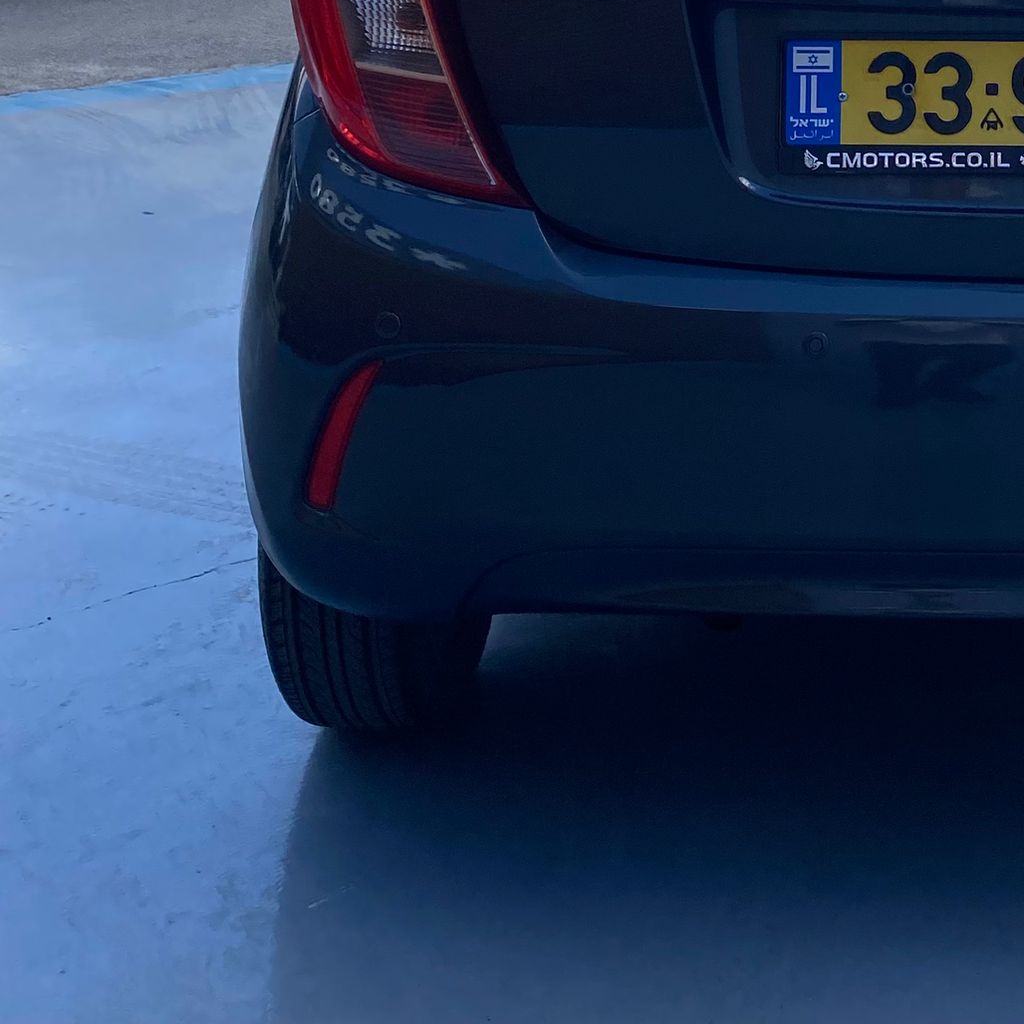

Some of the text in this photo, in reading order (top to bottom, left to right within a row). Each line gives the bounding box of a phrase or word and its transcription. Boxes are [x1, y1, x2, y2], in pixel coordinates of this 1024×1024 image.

[799, 74, 828, 114] IL
[789, 115, 834, 128] ישראל
[826, 151, 1011, 168] CMOTORS.CO.IL
